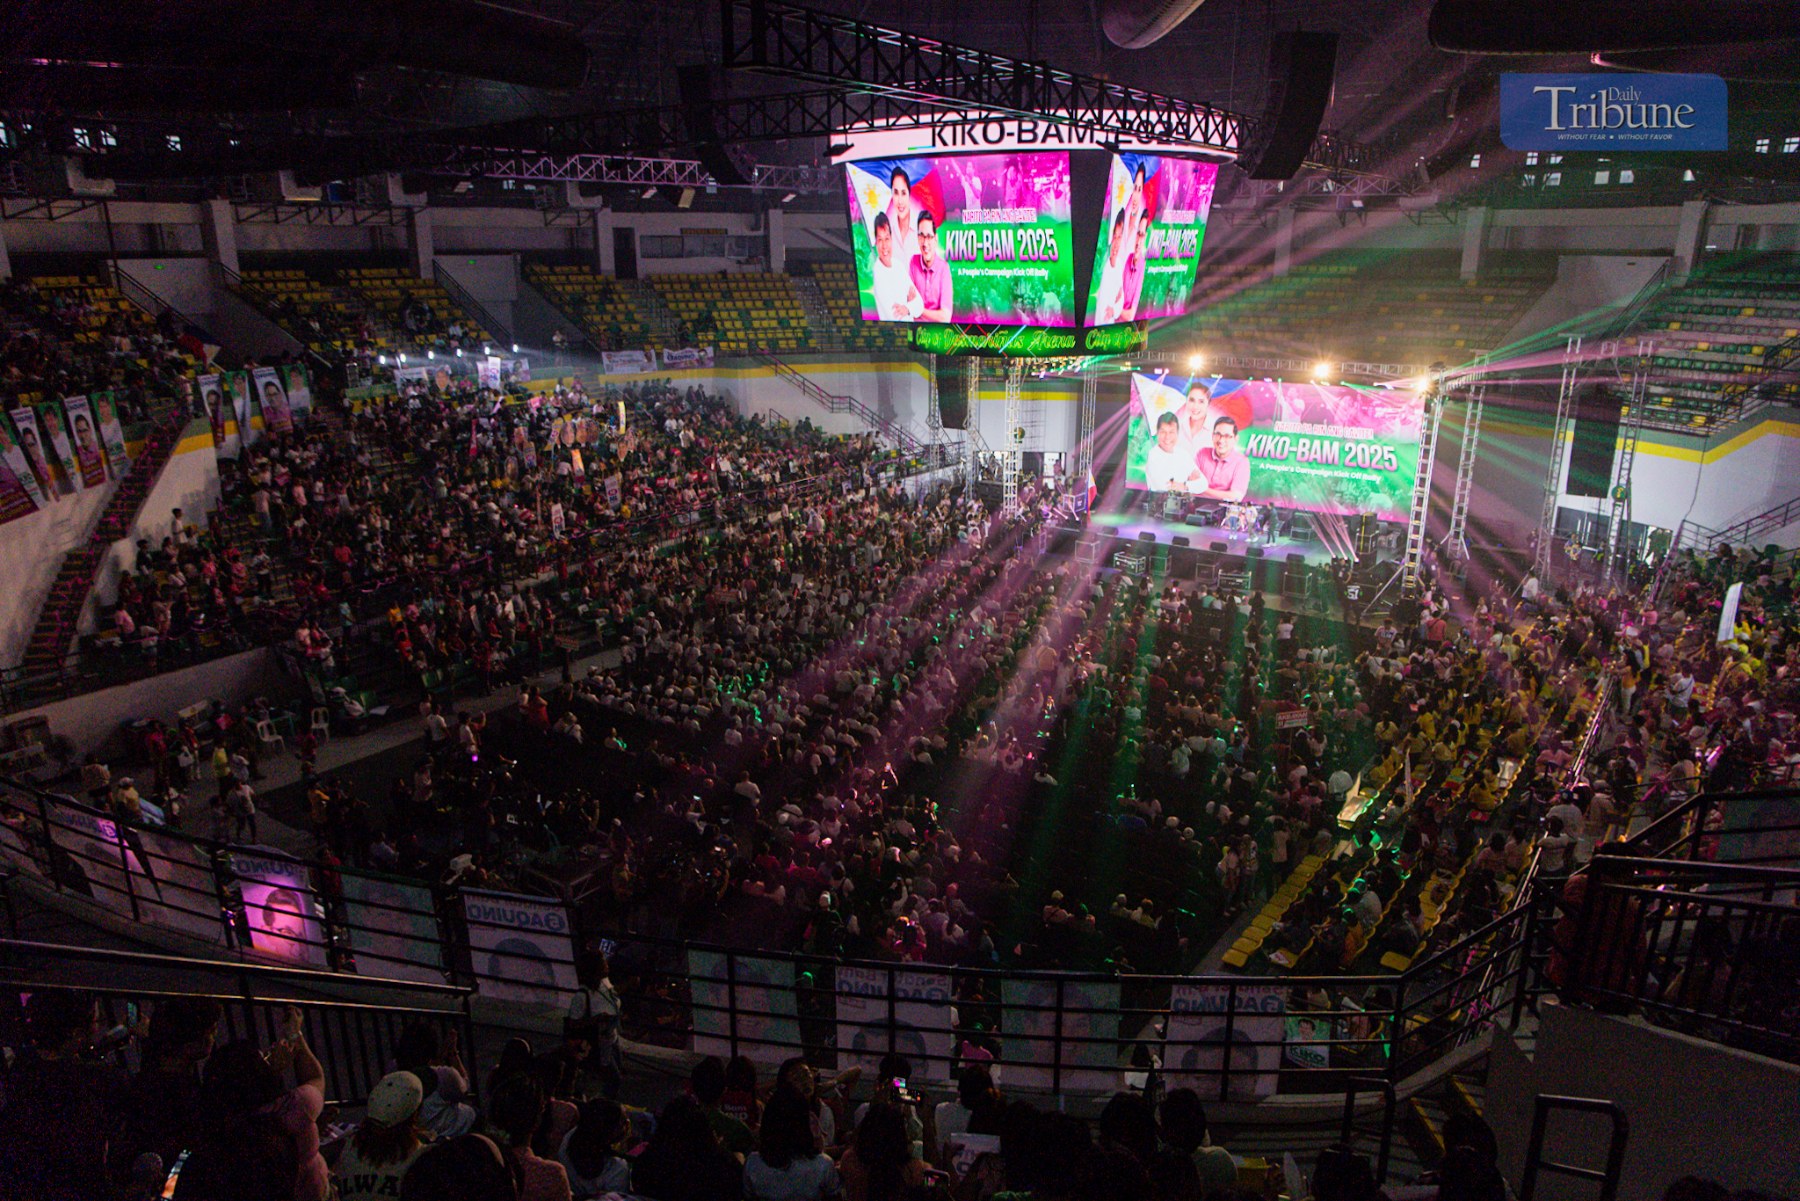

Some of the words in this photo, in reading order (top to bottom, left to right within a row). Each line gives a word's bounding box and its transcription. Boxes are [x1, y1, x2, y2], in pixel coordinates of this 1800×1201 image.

[931, 117, 1096, 148] KIKO-BAM
[945, 229, 1015, 262] KIKO-BAM
[1017, 228, 1059, 262] 2025
[1245, 433, 1340, 466] KIKO-BAM
[1344, 442, 1399, 473] 2025
[1265, 463, 1294, 473] People's
[1295, 465, 1333, 477] Campaign
